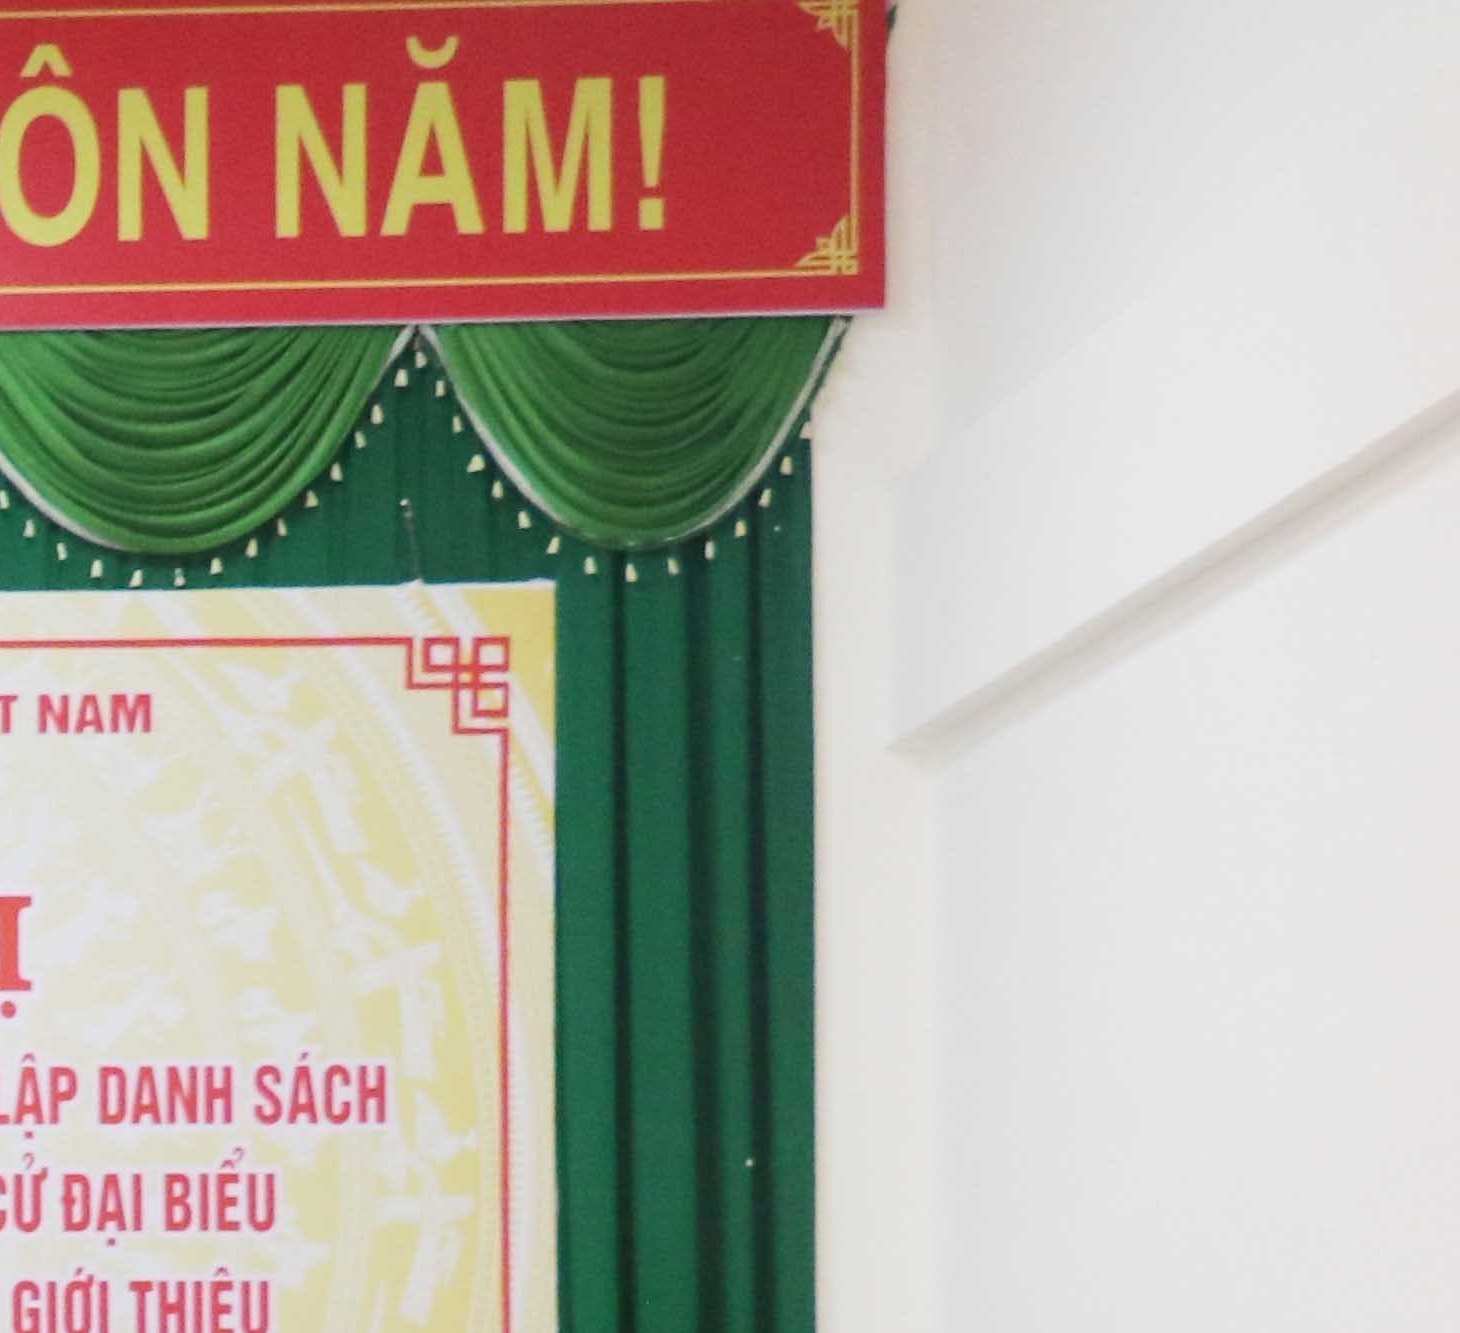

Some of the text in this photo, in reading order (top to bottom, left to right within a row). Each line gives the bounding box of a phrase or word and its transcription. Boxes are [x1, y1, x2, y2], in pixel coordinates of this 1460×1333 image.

[274, 35, 666, 238] NĂM!
[36, 693, 153, 735] NAM
[98, 1065, 233, 1126] DANH
[253, 1052, 387, 1125] SÁCH
[61, 1172, 143, 1246] ĐẠI
[163, 1147, 276, 1232] BIỂU
